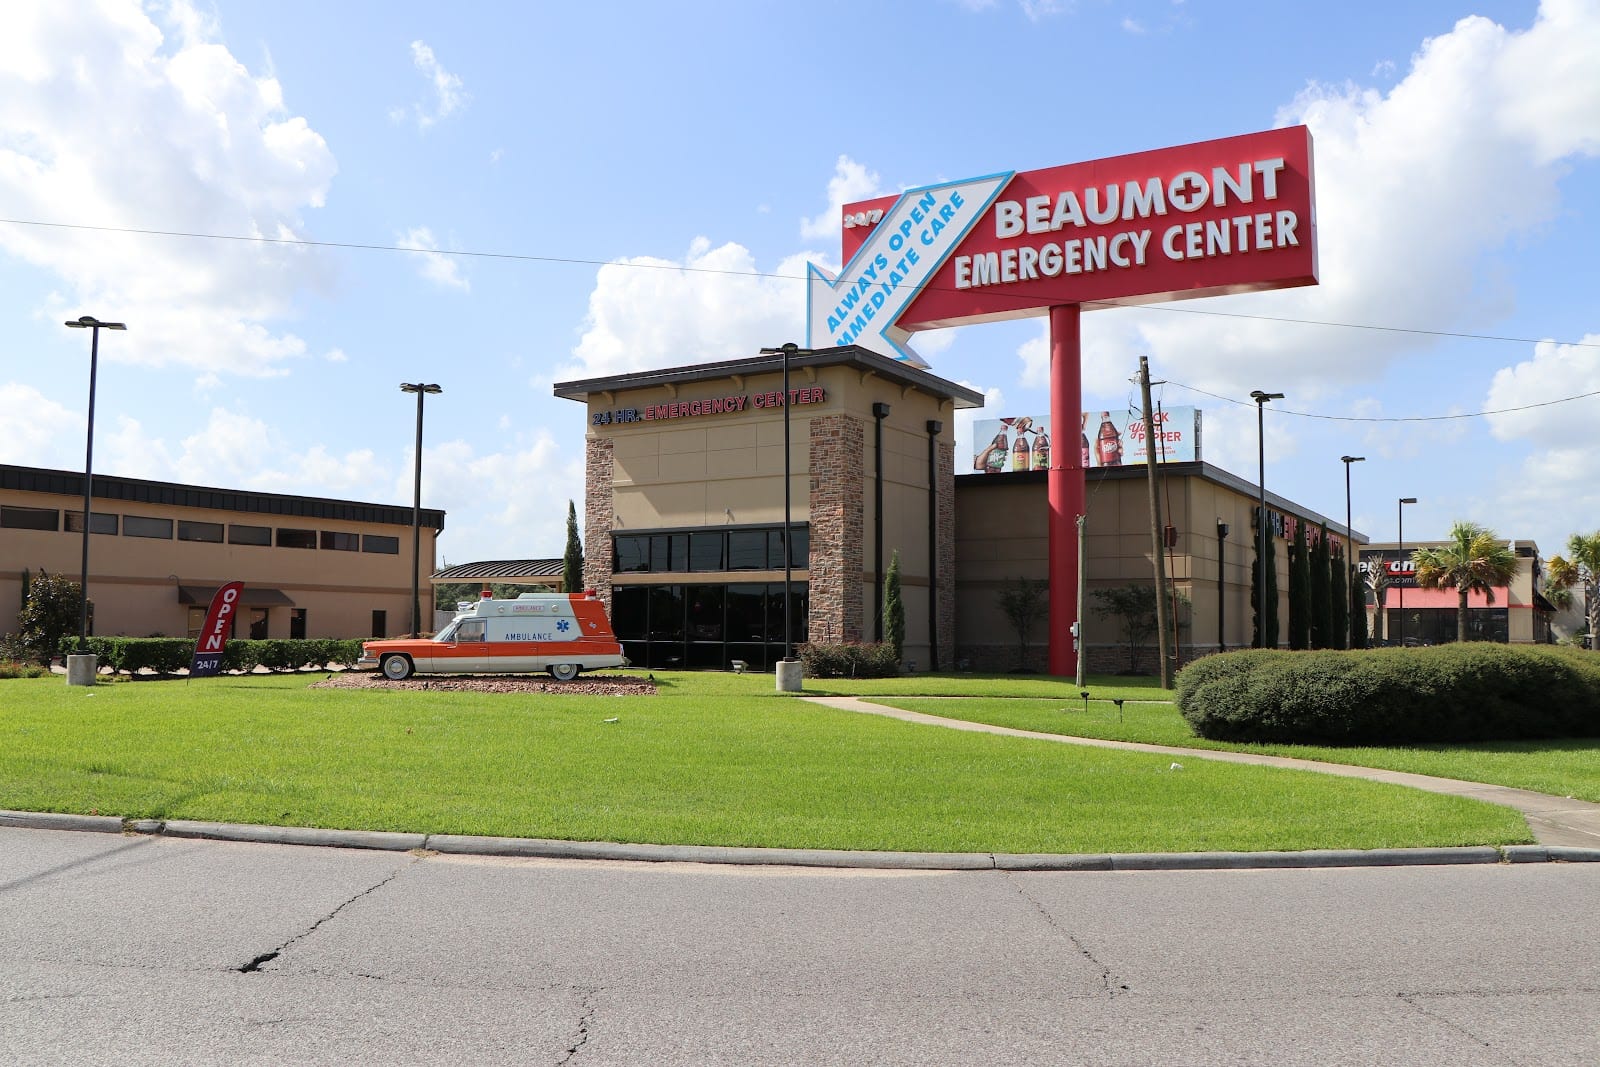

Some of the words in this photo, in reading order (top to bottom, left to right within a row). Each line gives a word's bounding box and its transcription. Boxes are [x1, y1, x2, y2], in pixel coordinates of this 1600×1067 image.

[995, 157, 1286, 239] BEAUMONT
[826, 253, 888, 334] ALWAYS
[889, 191, 937, 251] OPEN
[836, 248, 920, 346] MMEDIATE
[920, 191, 965, 246] CARE
[955, 229, 1152, 290] EMERGENCY
[1163, 210, 1299, 261] CENTER
[592, 411, 611, 425] 24
[614, 408, 640, 423] HR.
[644, 395, 747, 420] EMERGENCY
[752, 387, 825, 408] CENTER
[1138, 431, 1182, 443] PPPER
[206, 588, 237, 650] OPEN
[505, 633, 552, 641] AMBULANCE
[197, 660, 218, 669] 24/7
